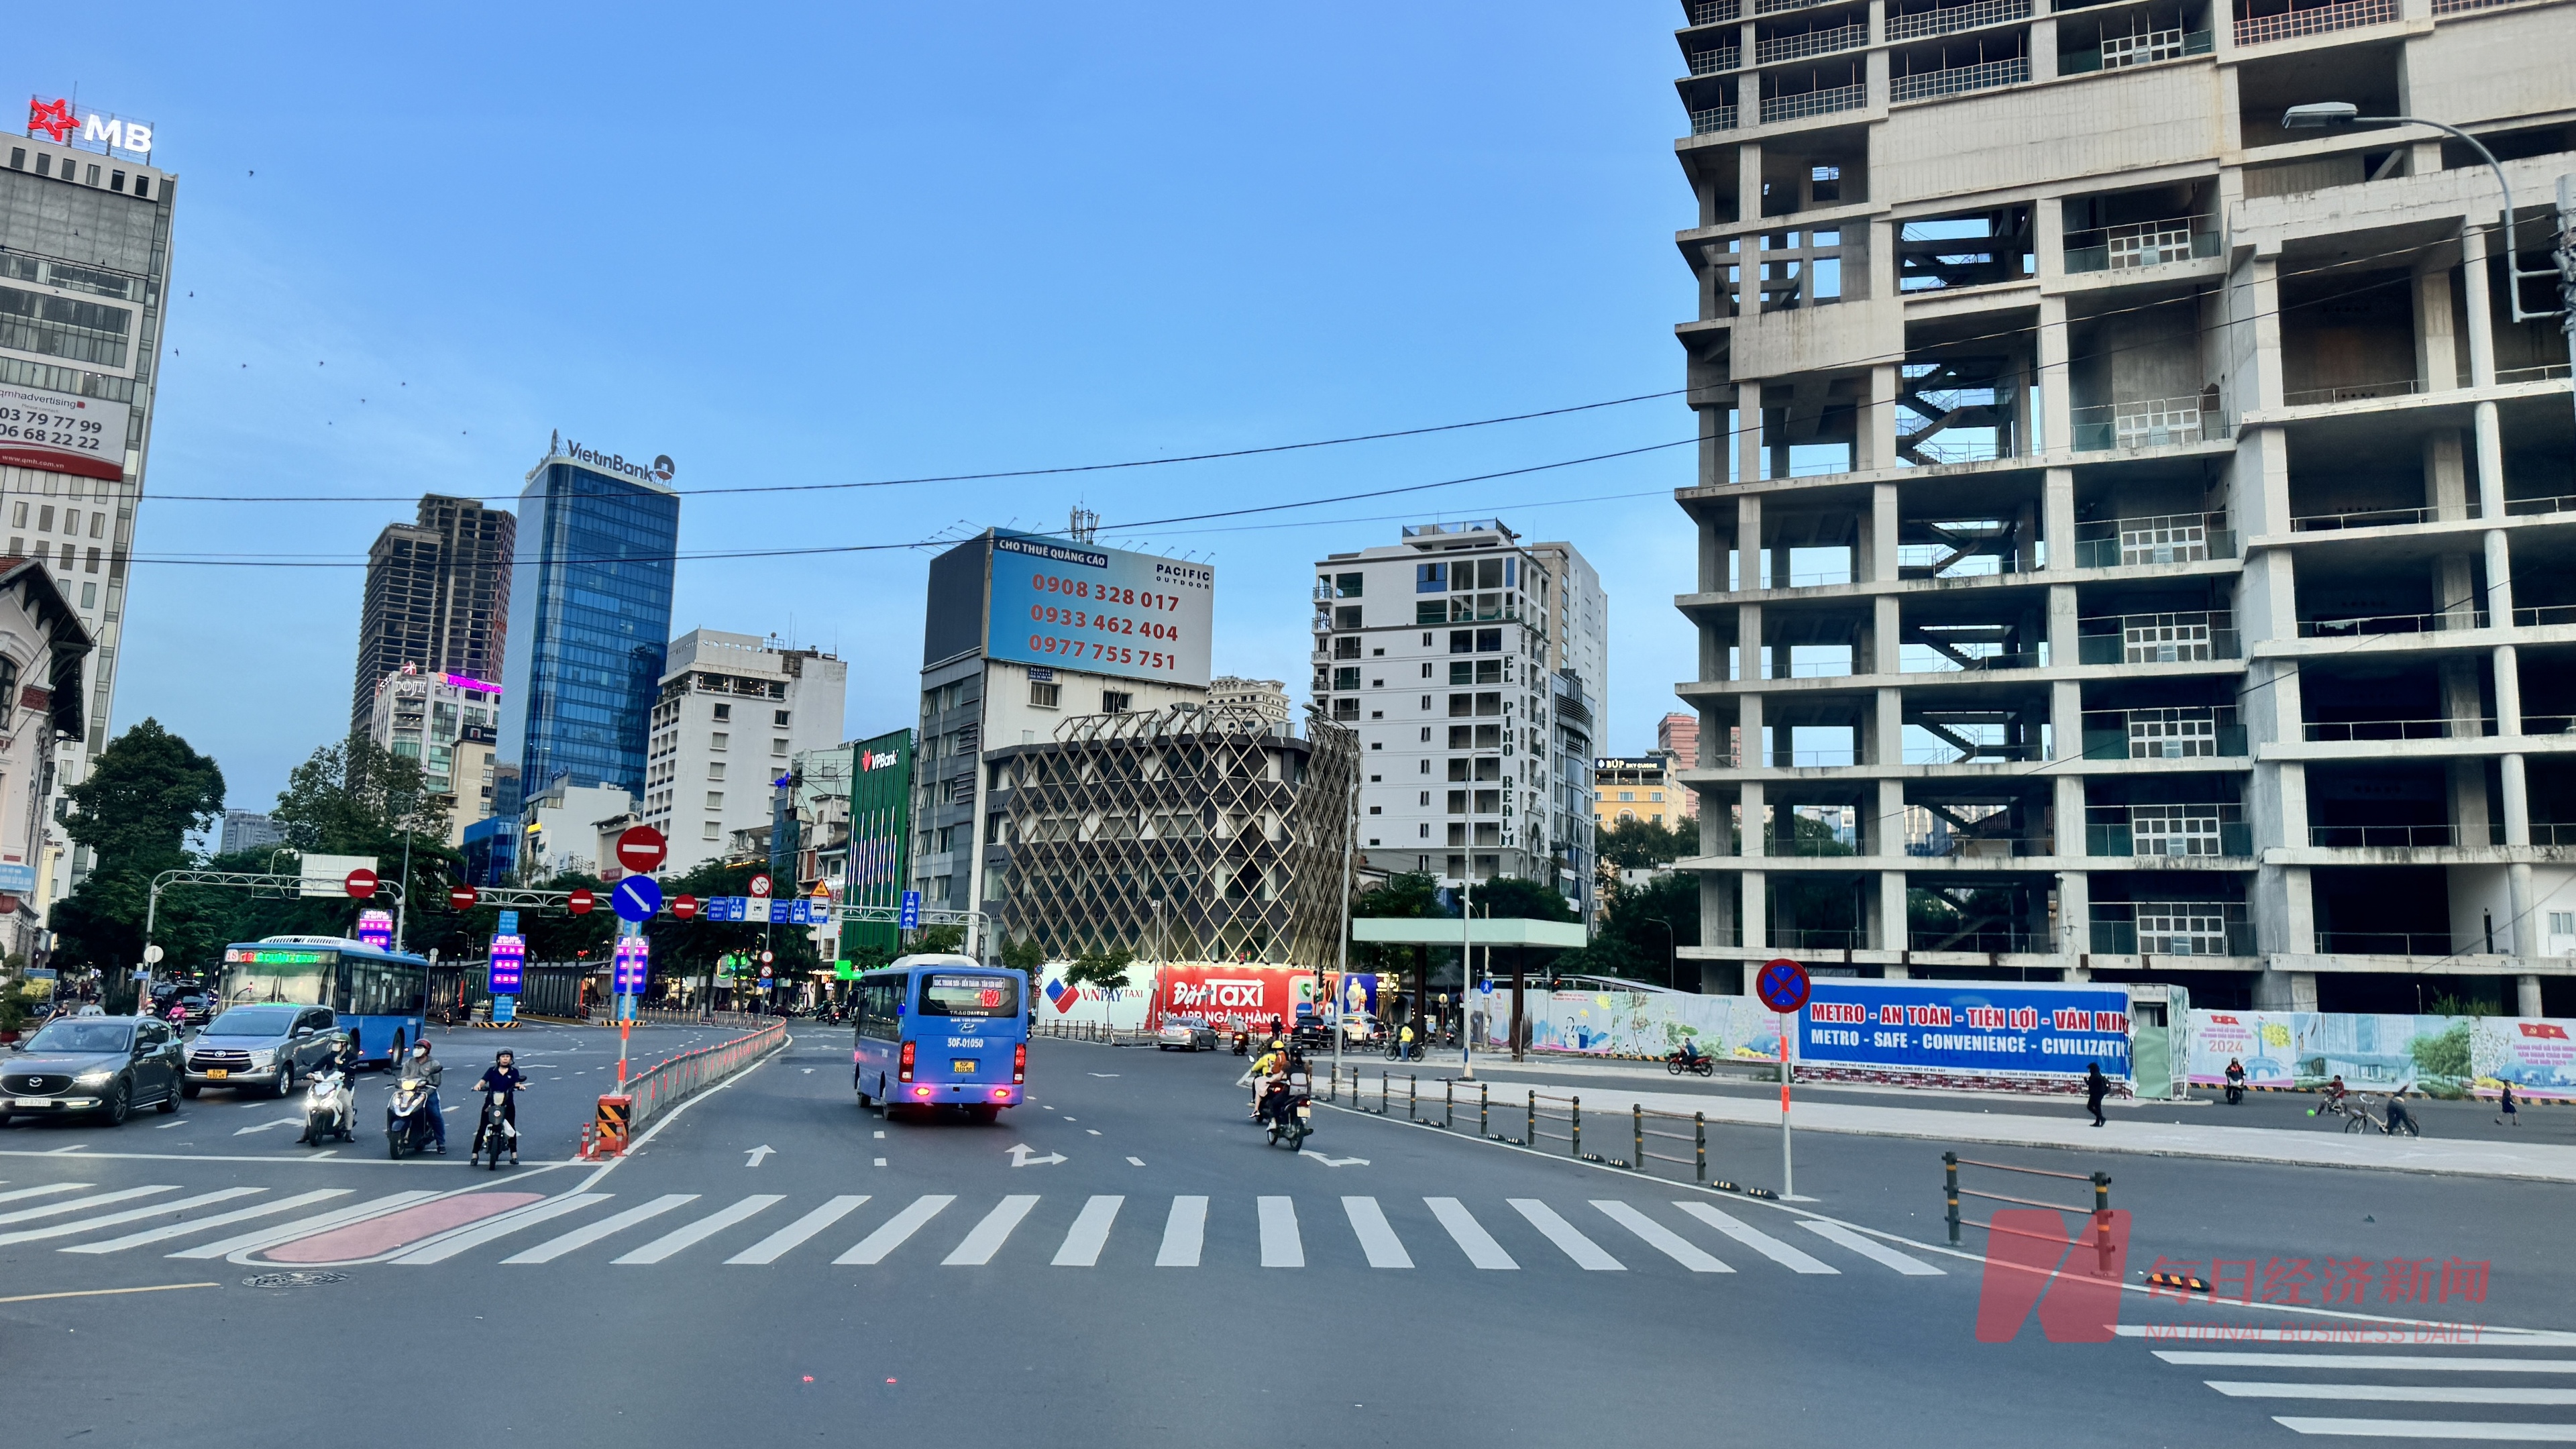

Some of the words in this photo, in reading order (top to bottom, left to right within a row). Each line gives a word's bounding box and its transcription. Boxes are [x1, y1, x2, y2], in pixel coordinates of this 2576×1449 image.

[85, 113, 152, 153] MB
[0, 390, 76, 409] qmhadvertising
[27, 411, 48, 425] 79
[54, 415, 75, 429] 77
[80, 420, 102, 433] 99
[23, 428, 46, 441] 68
[51, 432, 72, 446] 22
[77, 436, 99, 450] 22
[2, 455, 64, 468] www.qmh.com.vn
[568, 439, 653, 482] VietinBank
[999, 540, 1019, 551] CHO
[1022, 543, 1049, 557] THUÊ
[1050, 546, 1084, 563] QUẢNG
[1086, 552, 1106, 566] CÁO
[1156, 576, 1210, 590] OUTDOOR
[1157, 564, 1210, 581] PACIFIC
[1032, 574, 1088, 598] 0908
[1094, 584, 1134, 605] 328
[1140, 592, 1179, 611] 017
[1030, 604, 1086, 628] 0933
[1093, 614, 1132, 635] 462
[1139, 622, 1178, 641] 404
[1029, 634, 1085, 657] 0977
[1092, 643, 1132, 664] 755
[1139, 650, 1175, 669] 751
[1504, 655, 1514, 683] EL
[394, 680, 427, 696] DOJI
[1503, 701, 1514, 756] PINO
[872, 749, 899, 769] VPBank
[1606, 759, 1624, 768] BÚP
[1501, 775, 1514, 846] REALM
[241, 952, 254, 963] 18
[981, 989, 1000, 1007] 152
[1126, 989, 1143, 998] TAXI
[1173, 981, 1206, 1009] Đặt
[1205, 978, 1265, 1006] Taxi
[1811, 1003, 1866, 1024] METRO
[1880, 1005, 1903, 1025] AN
[1908, 1003, 1951, 1027] TOÀN
[1967, 1005, 2005, 1032] TIỆN
[2010, 1006, 2037, 1033] LỢI
[2053, 1007, 2090, 1032] VĂN
[1811, 1029, 1860, 1046] METRO
[1874, 1032, 1908, 1048] SAFE
[1923, 1033, 2027, 1053] CONVENIENCE
[2209, 1039, 2243, 1053] 2024
